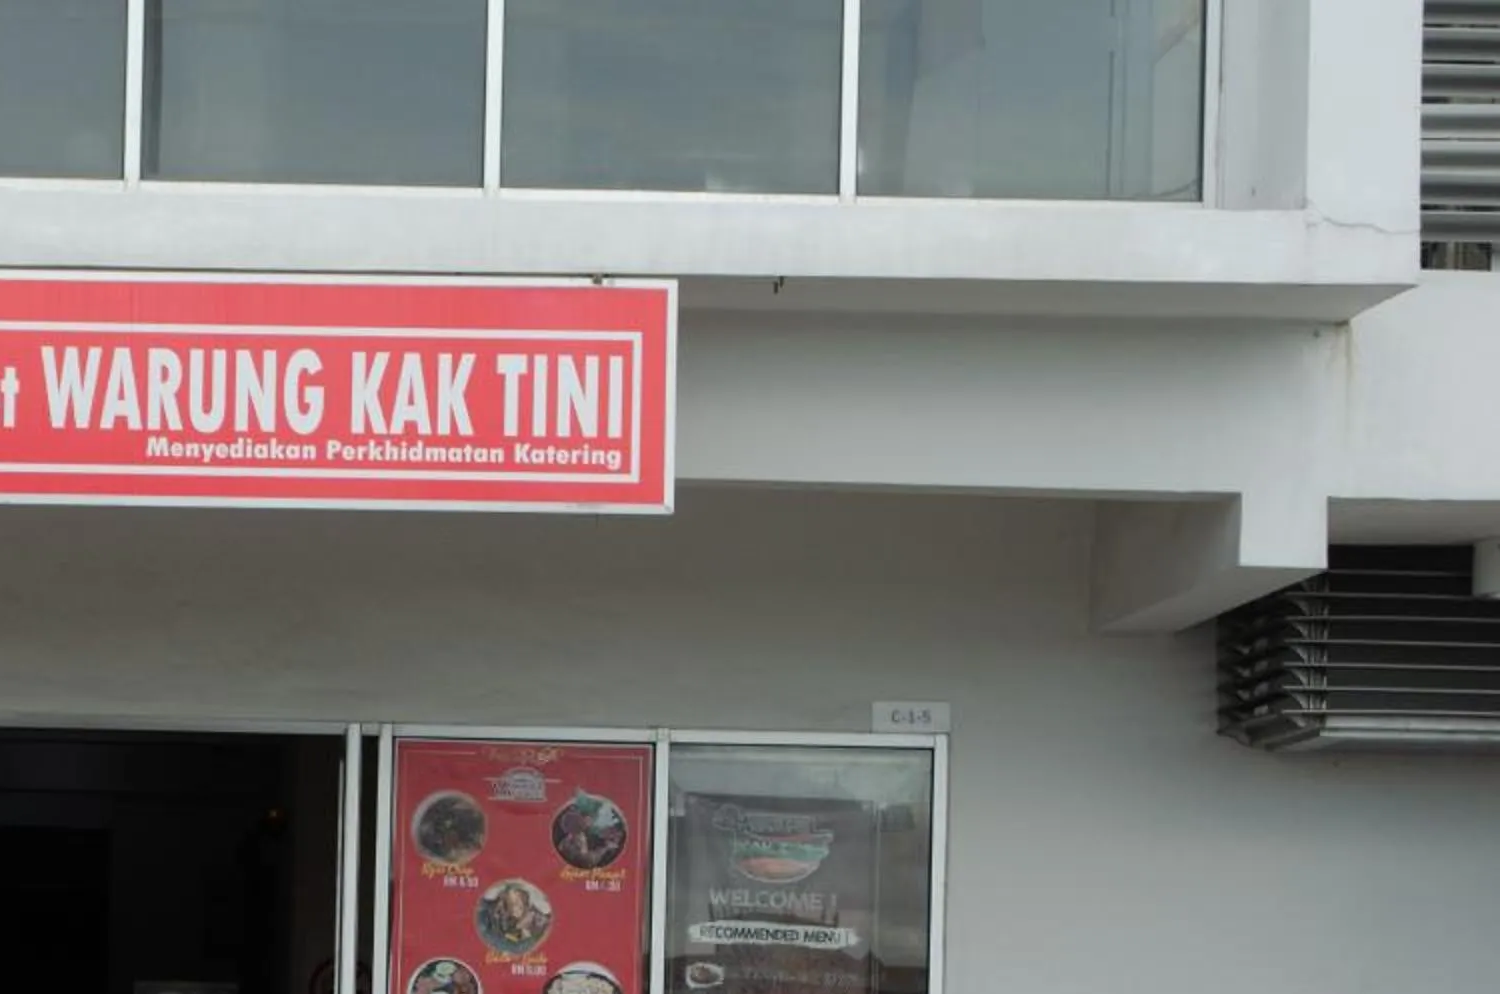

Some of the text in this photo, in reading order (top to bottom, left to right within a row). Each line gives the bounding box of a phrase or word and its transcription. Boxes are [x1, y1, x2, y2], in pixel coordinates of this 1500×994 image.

[41, 346, 324, 434] WARUNG
[351, 350, 477, 436] KAK
[496, 353, 622, 439] TINI
[146, 436, 622, 470] Menyediakan Perkhidmatan Katering
[708, 887, 824, 909] WELCOME
